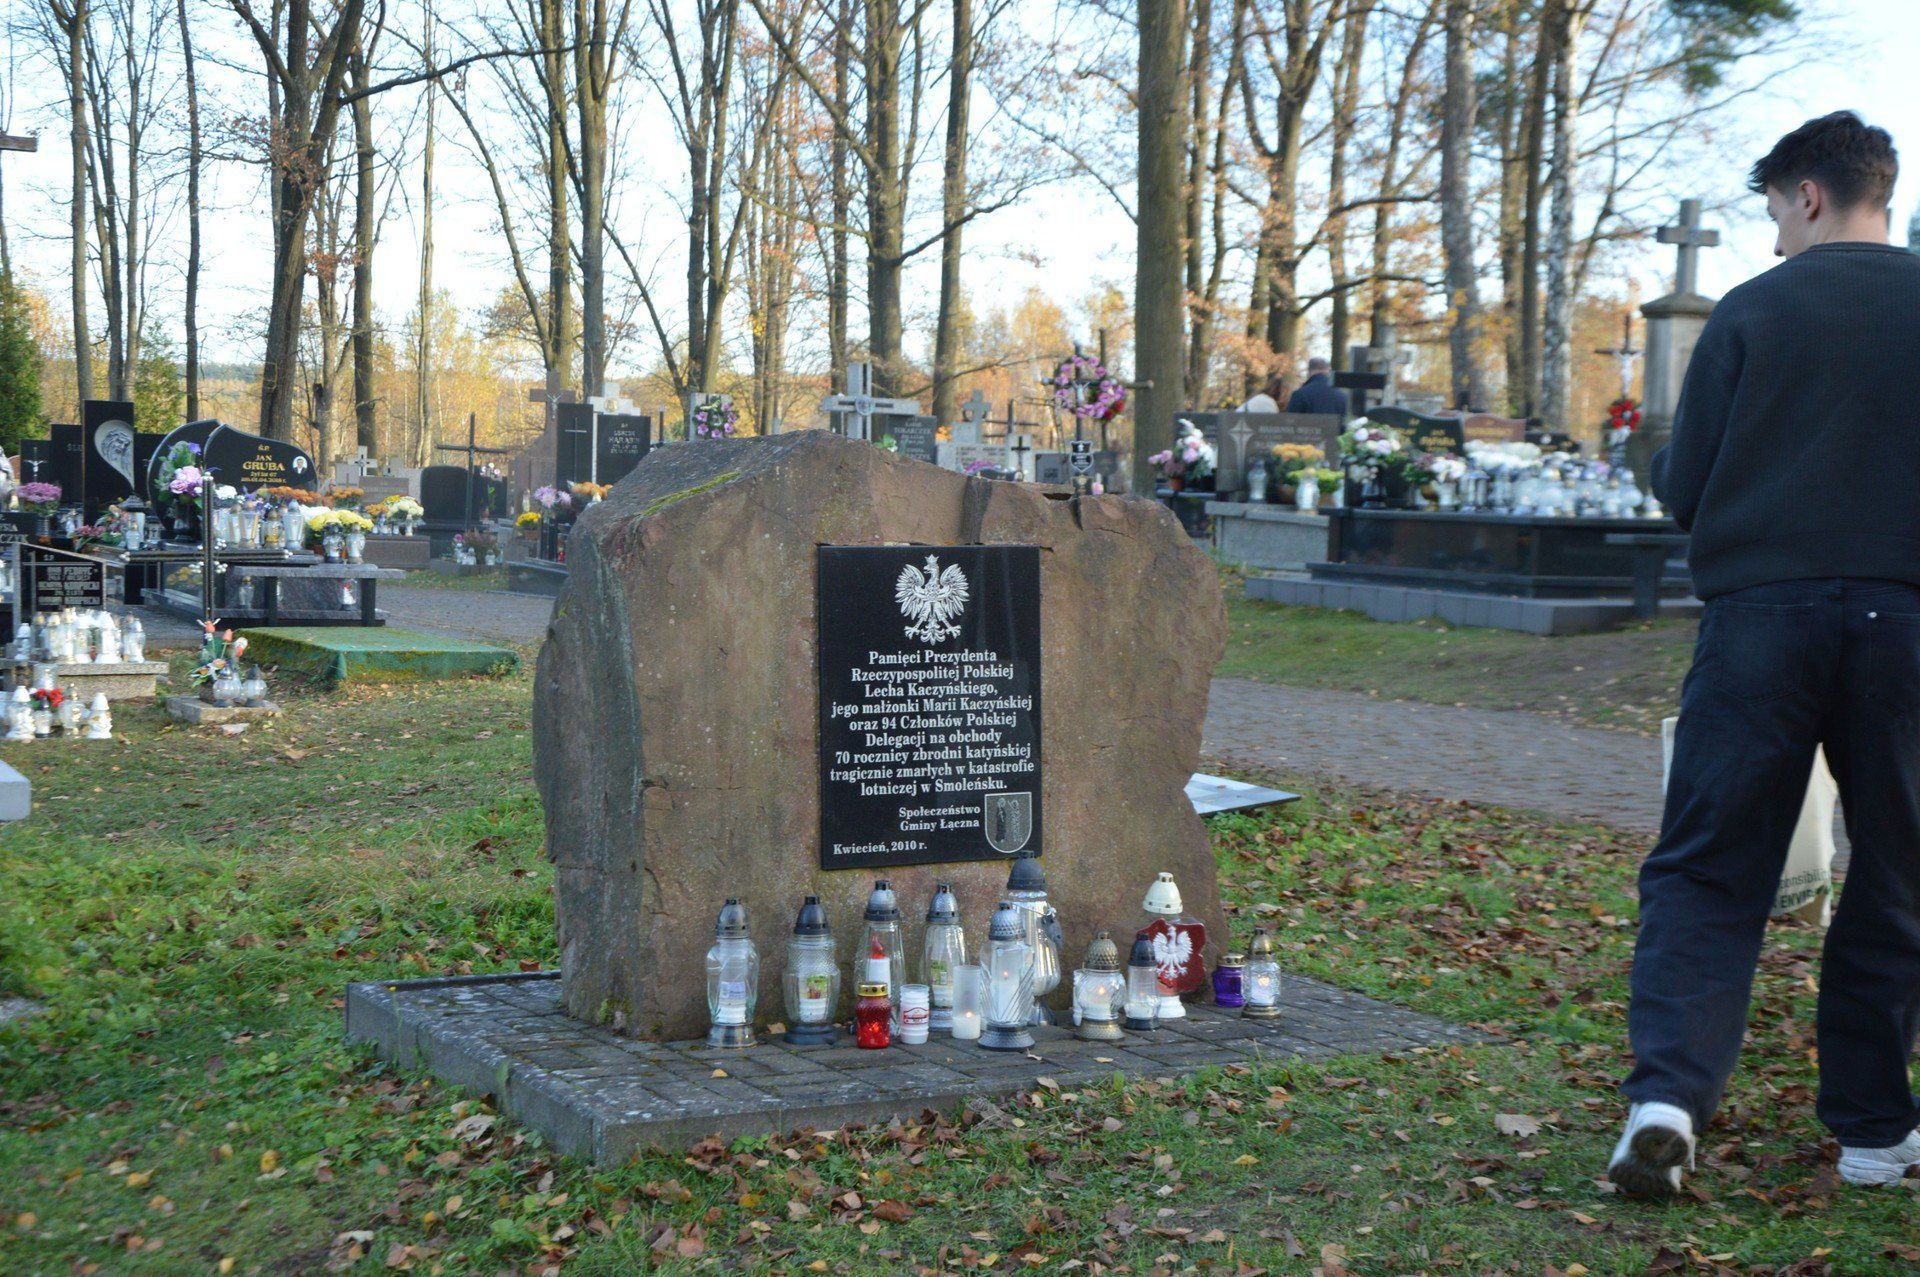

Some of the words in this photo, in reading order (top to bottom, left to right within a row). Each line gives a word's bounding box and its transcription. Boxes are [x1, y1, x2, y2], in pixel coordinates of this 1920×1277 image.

[242, 461, 286, 471] GRUBA
[869, 650, 921, 667] Pamięci
[924, 648, 997, 665] Prezydenta
[851, 666, 960, 684] Rzeczypospolitej
[963, 664, 1014, 680] Polskiej
[865, 683, 904, 698] Lecha
[907, 681, 998, 698] Kaczyńskiego,
[831, 702, 859, 718] jego
[862, 699, 920, 714] małżonki
[923, 697, 957, 713] Marii
[960, 696, 1033, 712] Kaczyńskiej
[849, 718, 878, 731] oraz
[881, 716, 897, 730] 94
[900, 714, 963, 729] Członków
[966, 712, 1017, 727] Polskiej
[866, 732, 926, 748] Delegacji
[930, 733, 946, 744] na
[949, 728, 1002, 744] obchody
[835, 750, 850, 764] 70
[853, 749, 908, 764] rocznicy
[912, 746, 962, 761] zbrodni
[966, 743, 1031, 759] katyńskiej
[830, 766, 893, 783] tragicznie
[896, 762, 952, 779] zmarłych
[956, 765, 966, 775] w
[969, 760, 1035, 775] katastrofie
[861, 781, 918, 797] lotniczej
[921, 782, 932, 793] w
[935, 777, 1008, 792] Smoleńsku.
[899, 804, 981, 818] Społeczeństwo
[900, 821, 937, 832] Gminy
[940, 818, 980, 831] Łączna
[833, 842, 889, 855] Kwiecień,
[891, 841, 917, 851] 2010
[918, 842, 927, 850] r.
